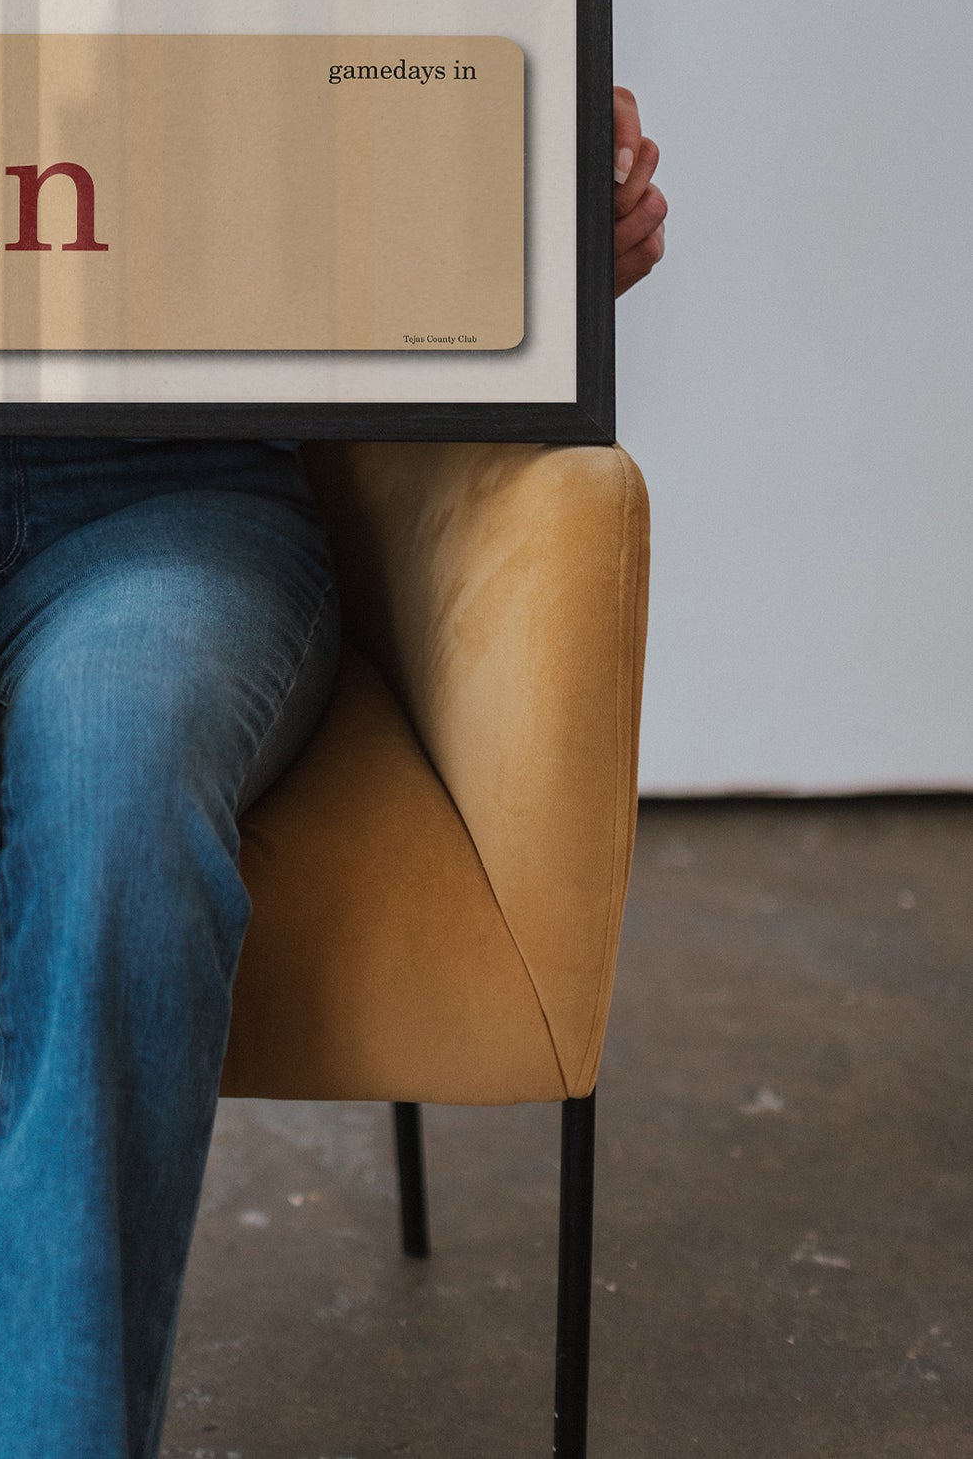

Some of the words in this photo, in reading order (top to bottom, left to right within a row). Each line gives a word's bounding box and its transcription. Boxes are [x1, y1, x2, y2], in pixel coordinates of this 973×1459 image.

[328, 58, 446, 85] gamedays
[453, 59, 477, 80] in
[402, 335, 425, 345] Tejas
[426, 335, 456, 345] County
[457, 335, 477, 343] Club
